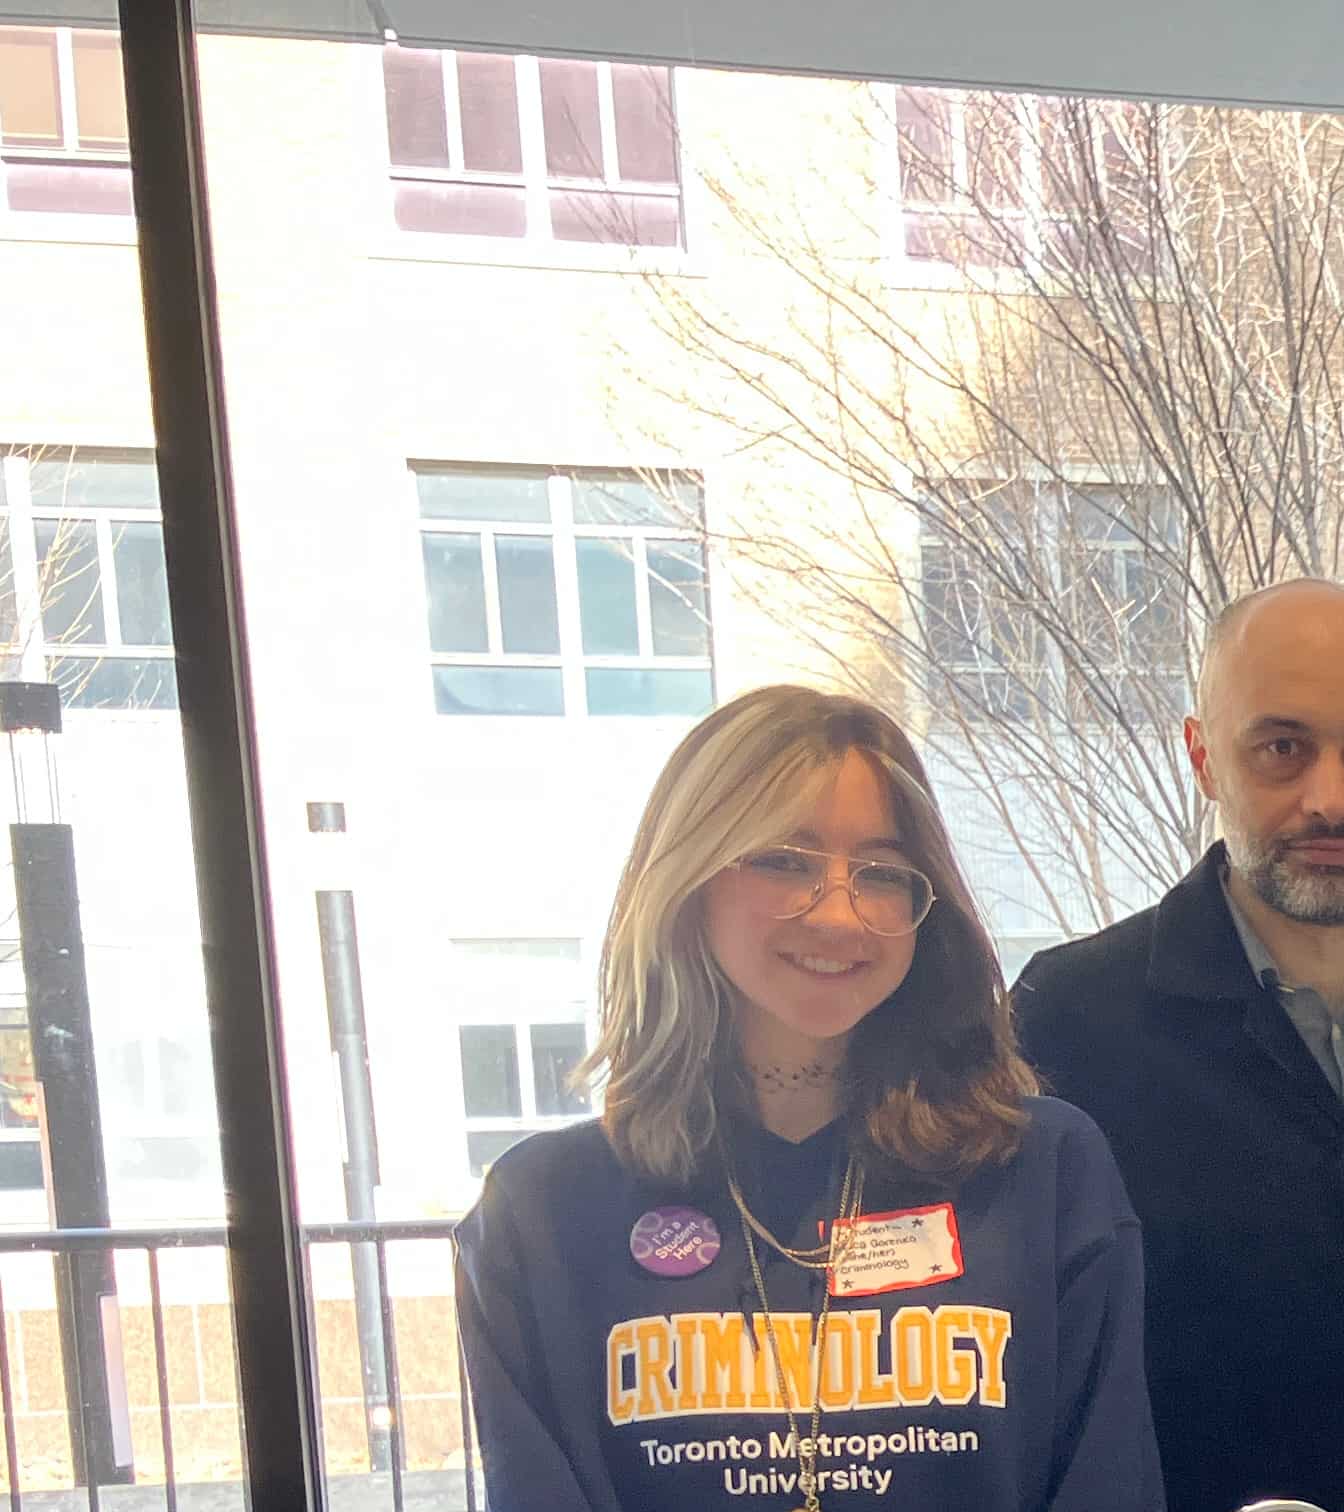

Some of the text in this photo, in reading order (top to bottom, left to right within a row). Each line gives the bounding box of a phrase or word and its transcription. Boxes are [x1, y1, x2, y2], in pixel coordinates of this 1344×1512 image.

[655, 1222, 700, 1259] Student
[673, 1236, 703, 1260] Here
[608, 1305, 1012, 1426] CRIMINOLOGY
[640, 1426, 979, 1467] Toronto Metropolitan
[724, 1465, 893, 1496] University
